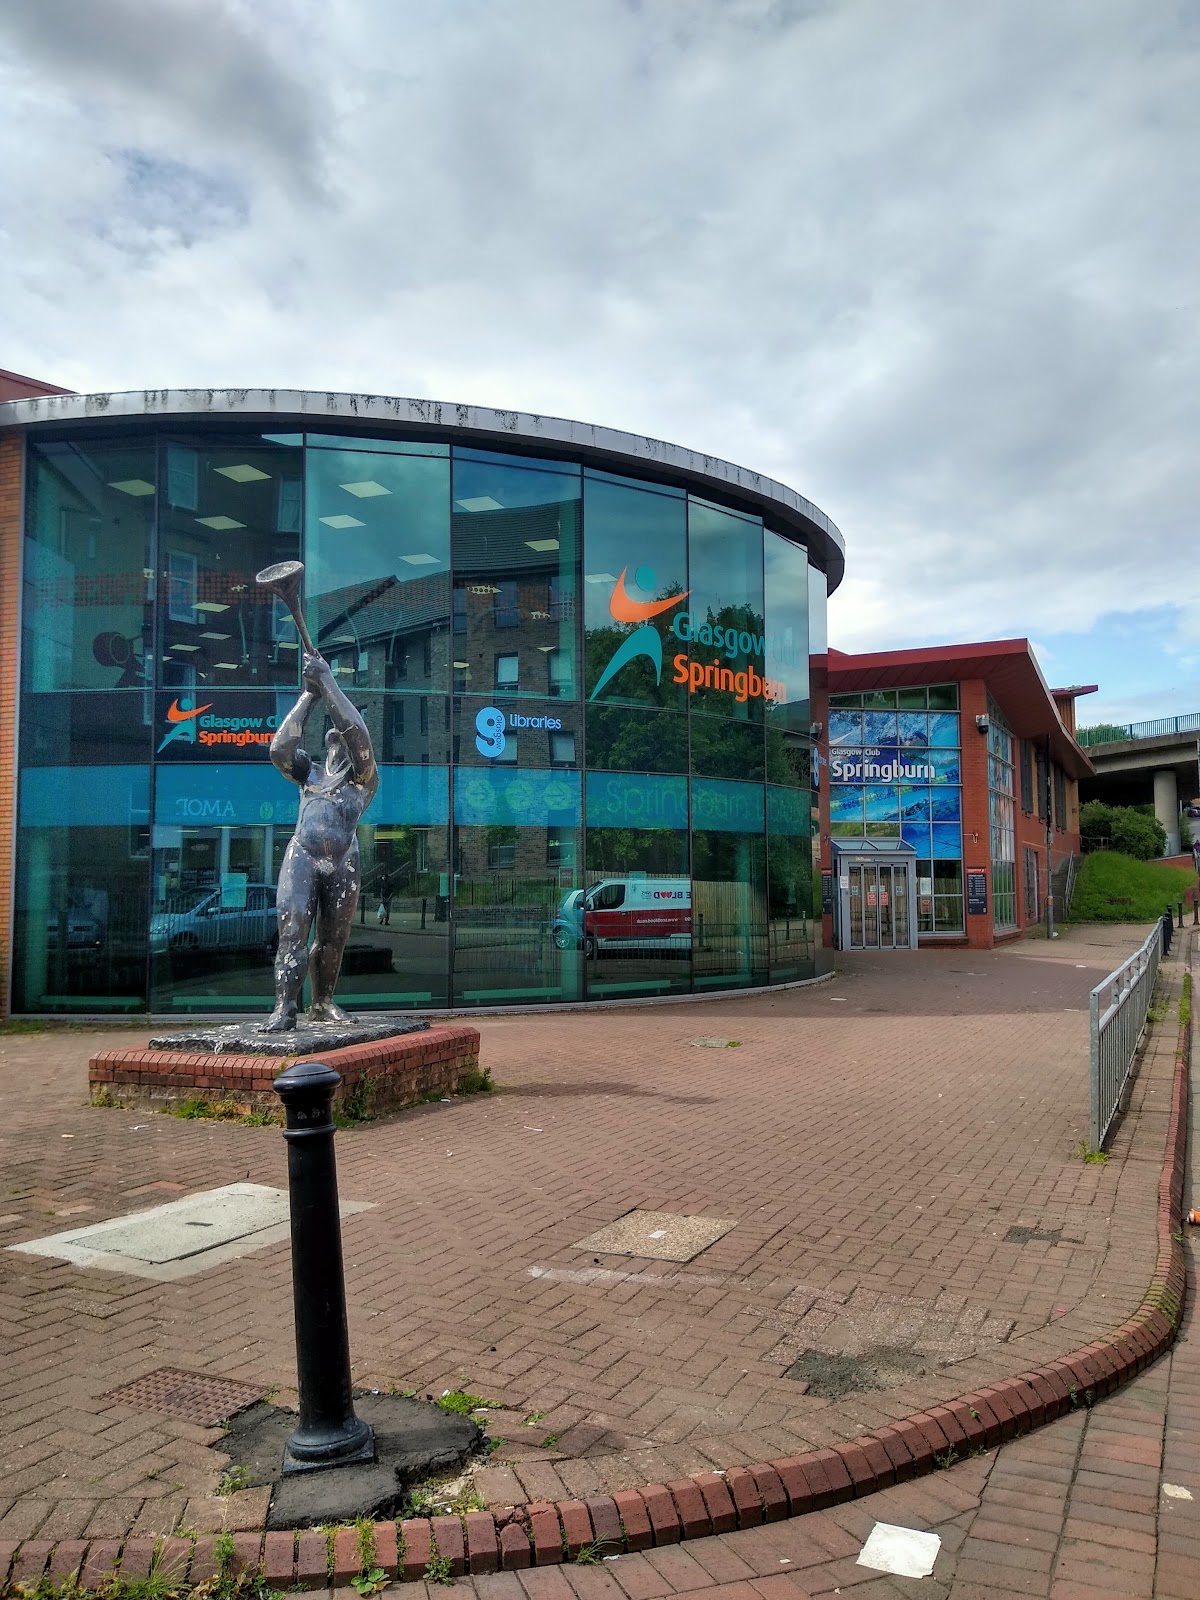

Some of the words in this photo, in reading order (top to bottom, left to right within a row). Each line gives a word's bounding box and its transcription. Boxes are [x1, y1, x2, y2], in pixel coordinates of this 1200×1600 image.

[672, 653, 787, 704] Springburn
[199, 714, 263, 730] Glasgow
[266, 714, 283, 728] Cl
[831, 747, 862, 757] Glasgow
[864, 748, 881, 756] Club
[832, 759, 936, 782] Springburn
